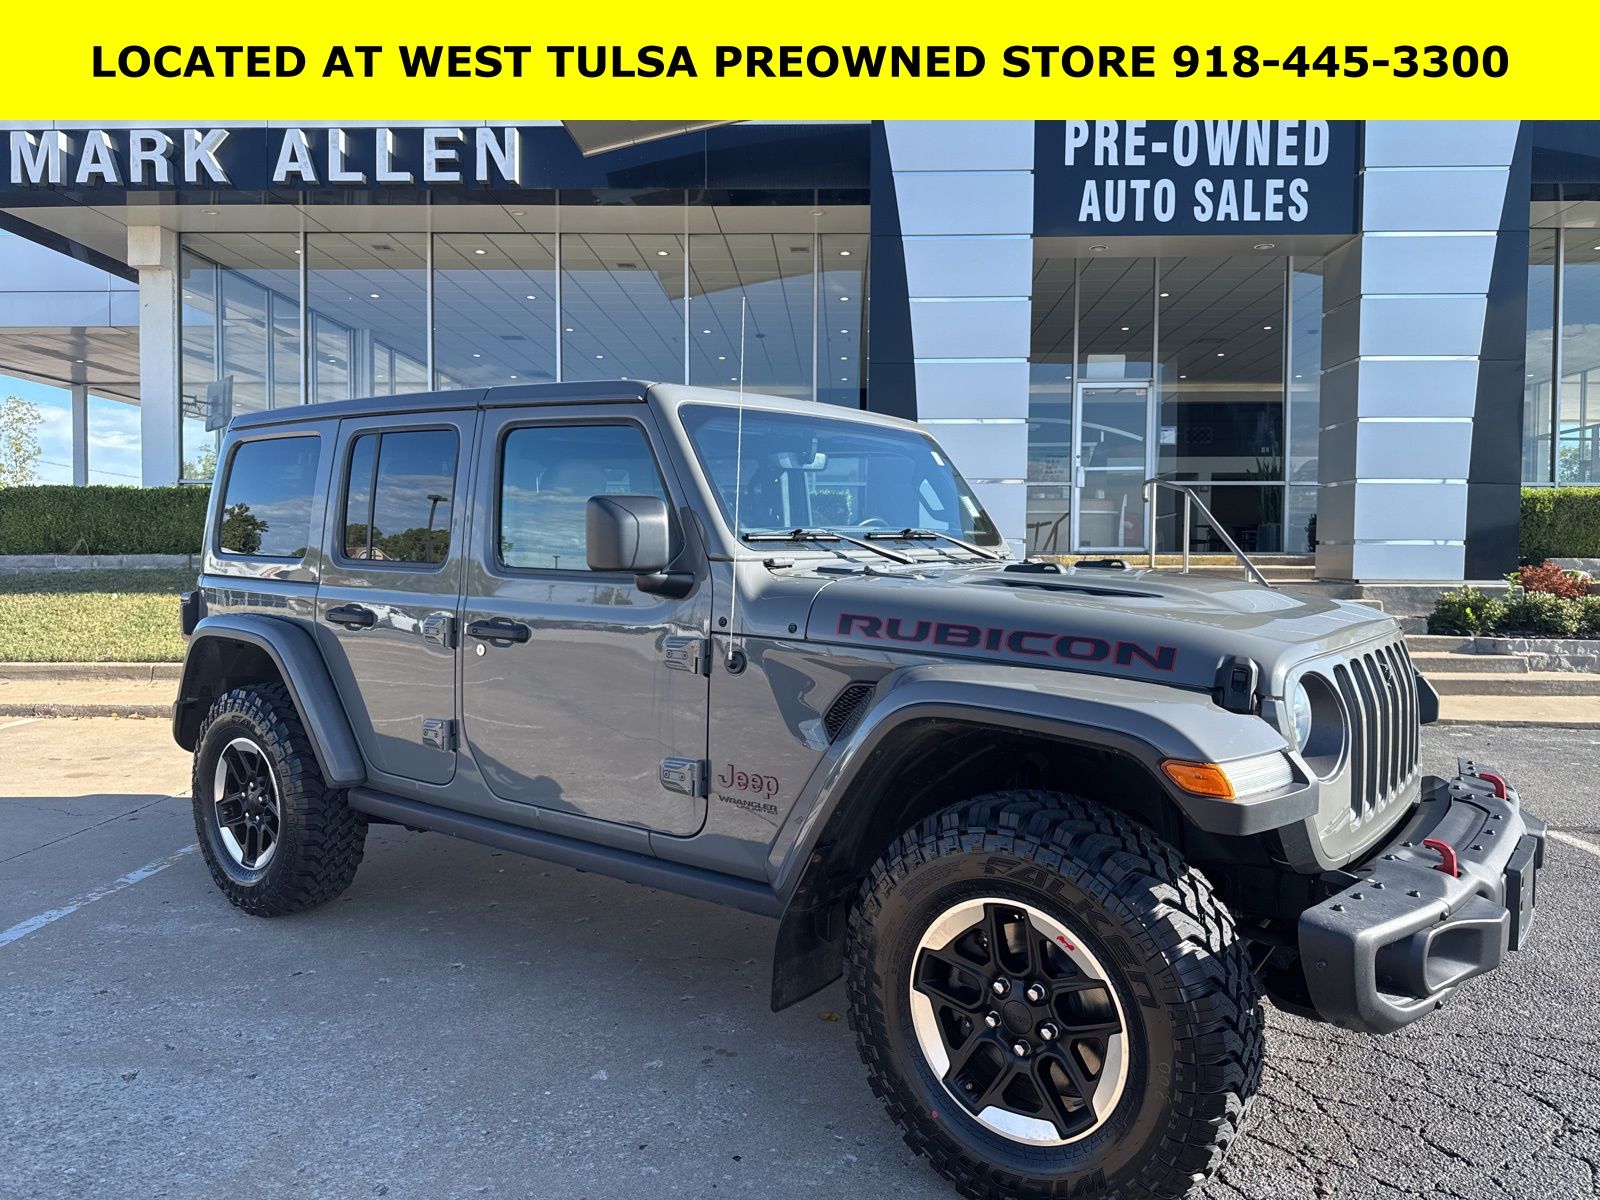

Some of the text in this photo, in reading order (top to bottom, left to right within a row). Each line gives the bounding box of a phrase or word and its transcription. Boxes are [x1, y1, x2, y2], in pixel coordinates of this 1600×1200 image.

[9, 127, 521, 186] MARK ALLEN
[1064, 119, 1329, 167] PRE-OWNED
[1078, 178, 1309, 222] AUTO SALES
[837, 613, 1178, 672] RUBICON
[717, 763, 779, 799] Jeep
[718, 794, 778, 812] WRANGLER
